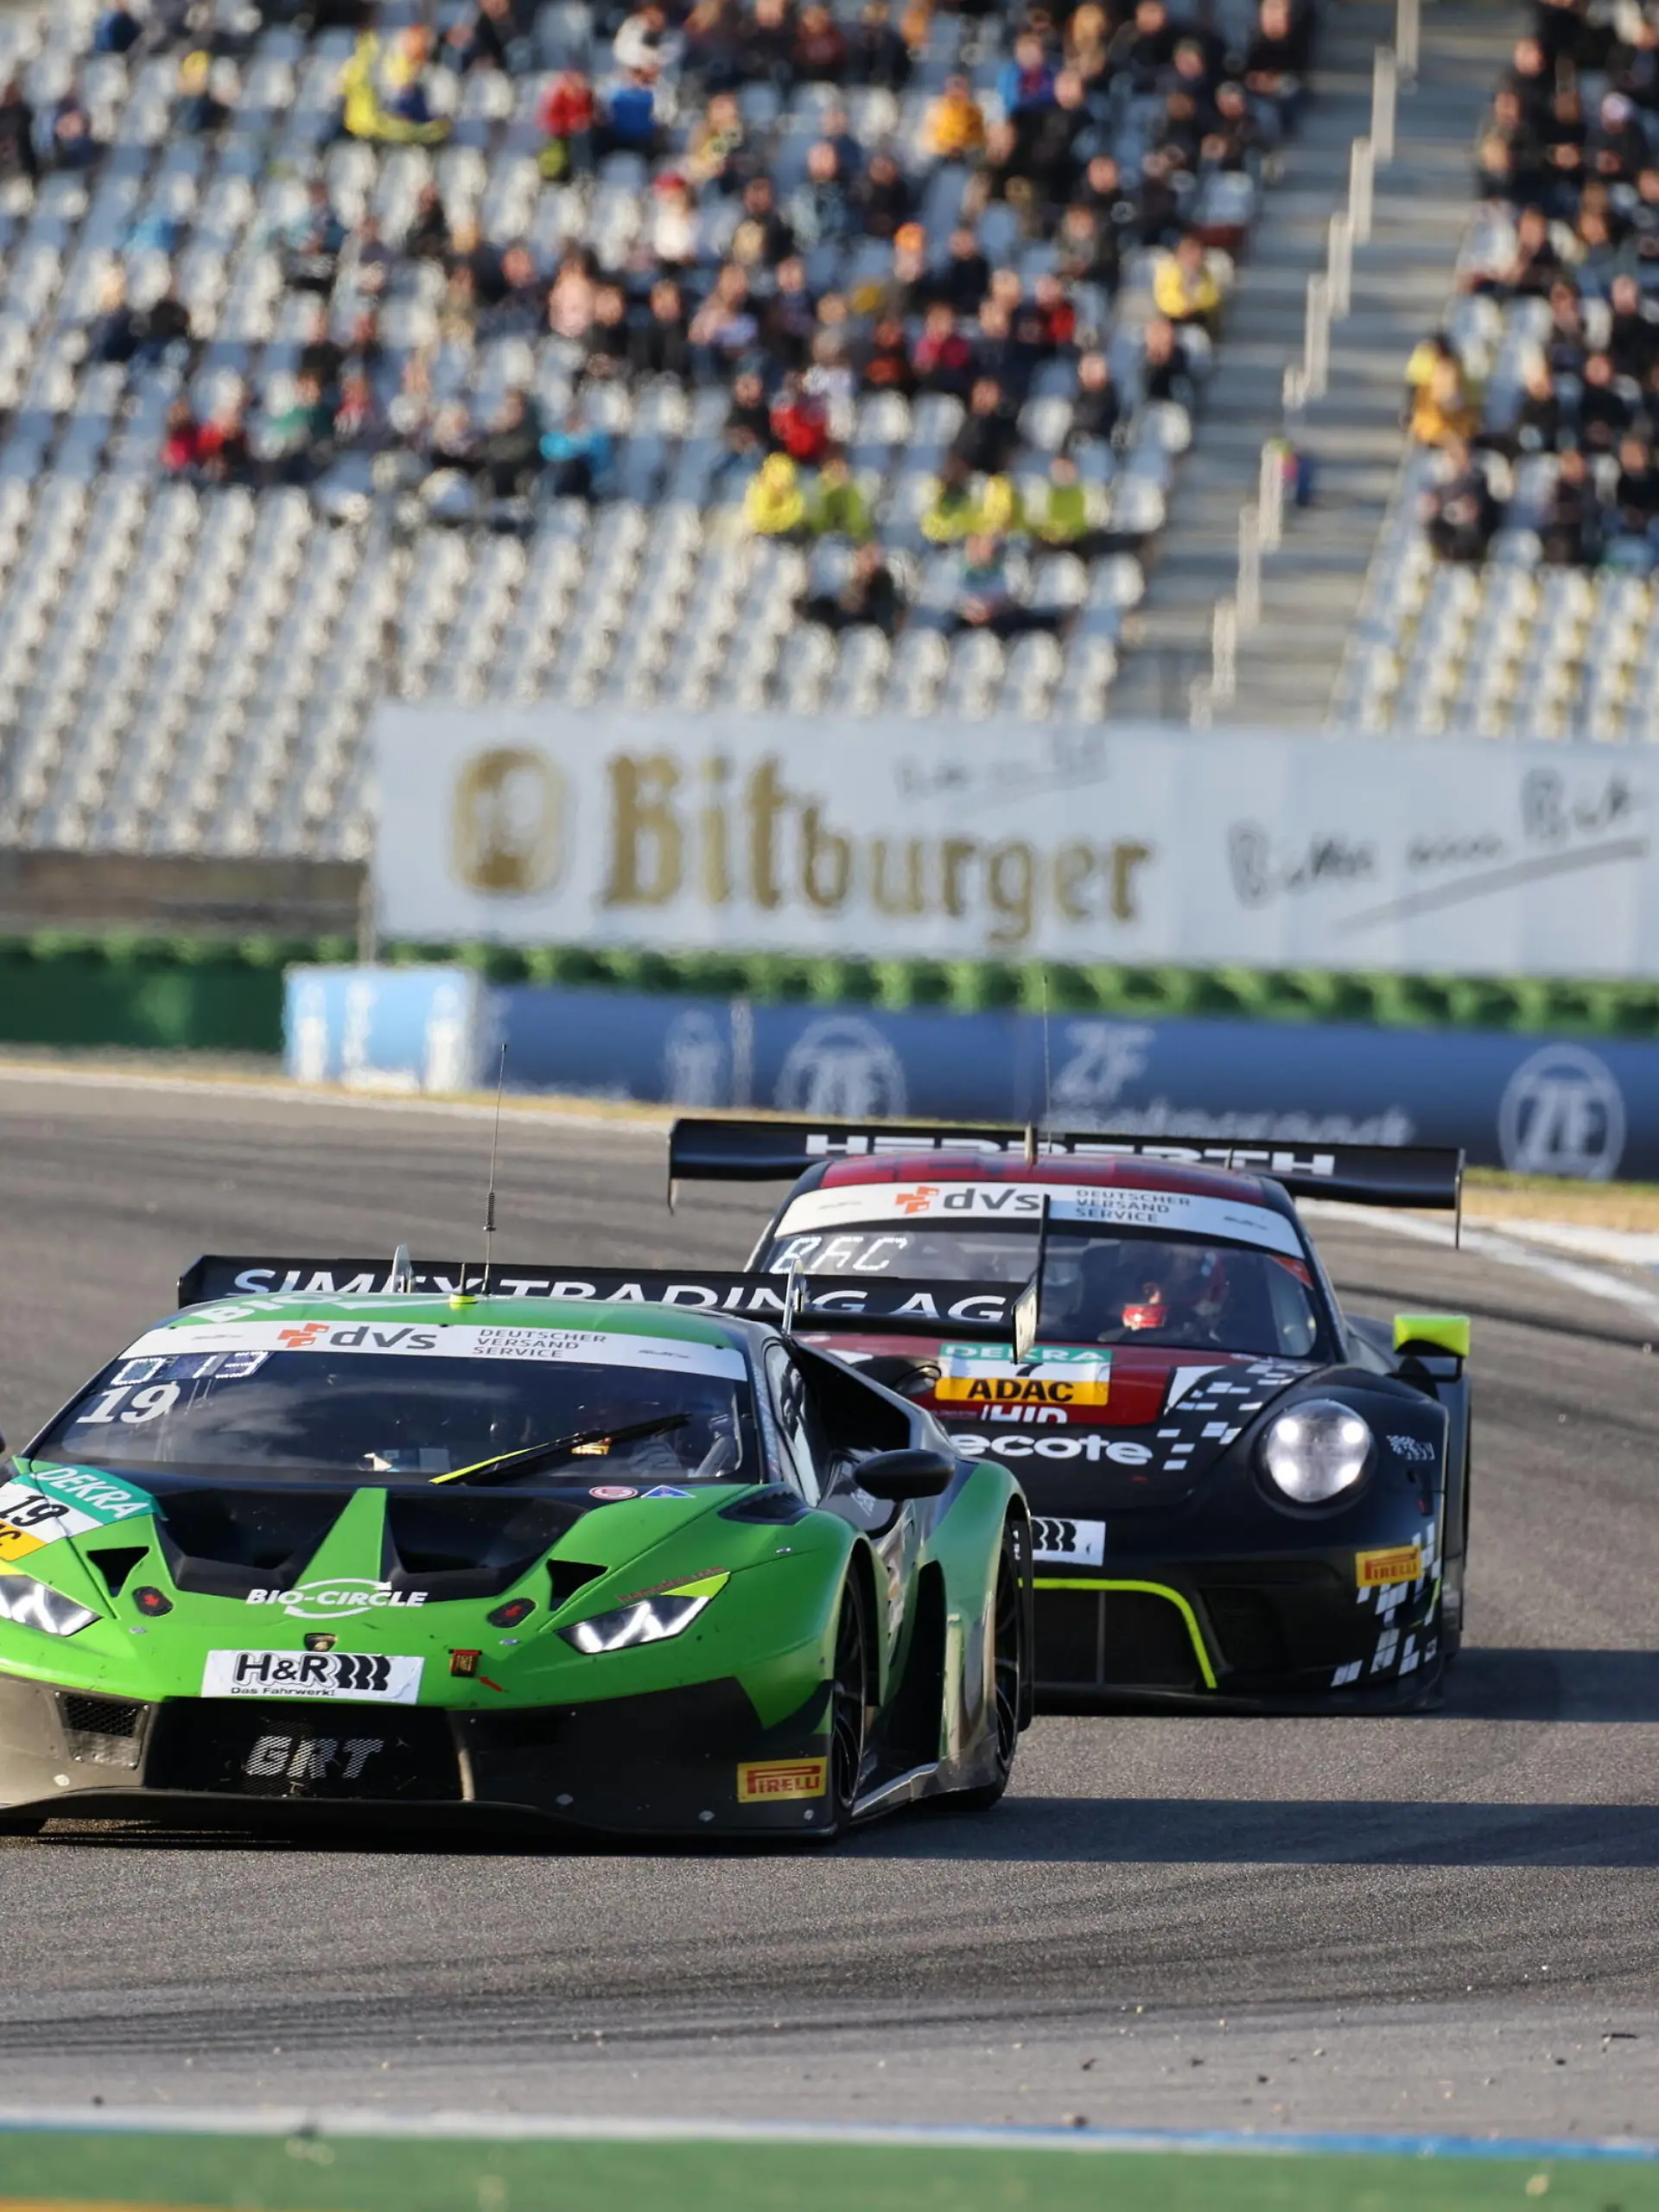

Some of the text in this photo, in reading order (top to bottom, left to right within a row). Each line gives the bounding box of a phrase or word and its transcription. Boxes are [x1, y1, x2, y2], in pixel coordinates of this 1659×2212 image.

[603, 752, 1153, 944] Bitburger
[1076, 1190, 1192, 1206] DEUTSCHER
[1076, 1198, 1170, 1214] VERSAND
[1074, 1207, 1159, 1224] SERVICE
[499, 1279, 869, 1313] TRADING
[889, 1294, 1007, 1323] AG
[477, 1338, 580, 1350] VERSAND
[480, 1329, 607, 1343] DEUTSCHER
[472, 1346, 563, 1359] SERVICE
[1009, 1361, 1044, 1377] 7
[76, 1381, 181, 1424] 19
[966, 1380, 1074, 1403] ADAC
[950, 1433, 1154, 1466] ecote
[29, 1467, 150, 1519] DEKRA
[0, 1495, 70, 1527] 19
[1363, 1548, 1418, 1581] PIRELLI
[245, 1588, 429, 1608] BIO-CIRCLE
[235, 1652, 337, 1687] H&R
[231, 1687, 335, 1697] Das Fahrwerk!
[746, 1764, 822, 1795] PIRELLI
